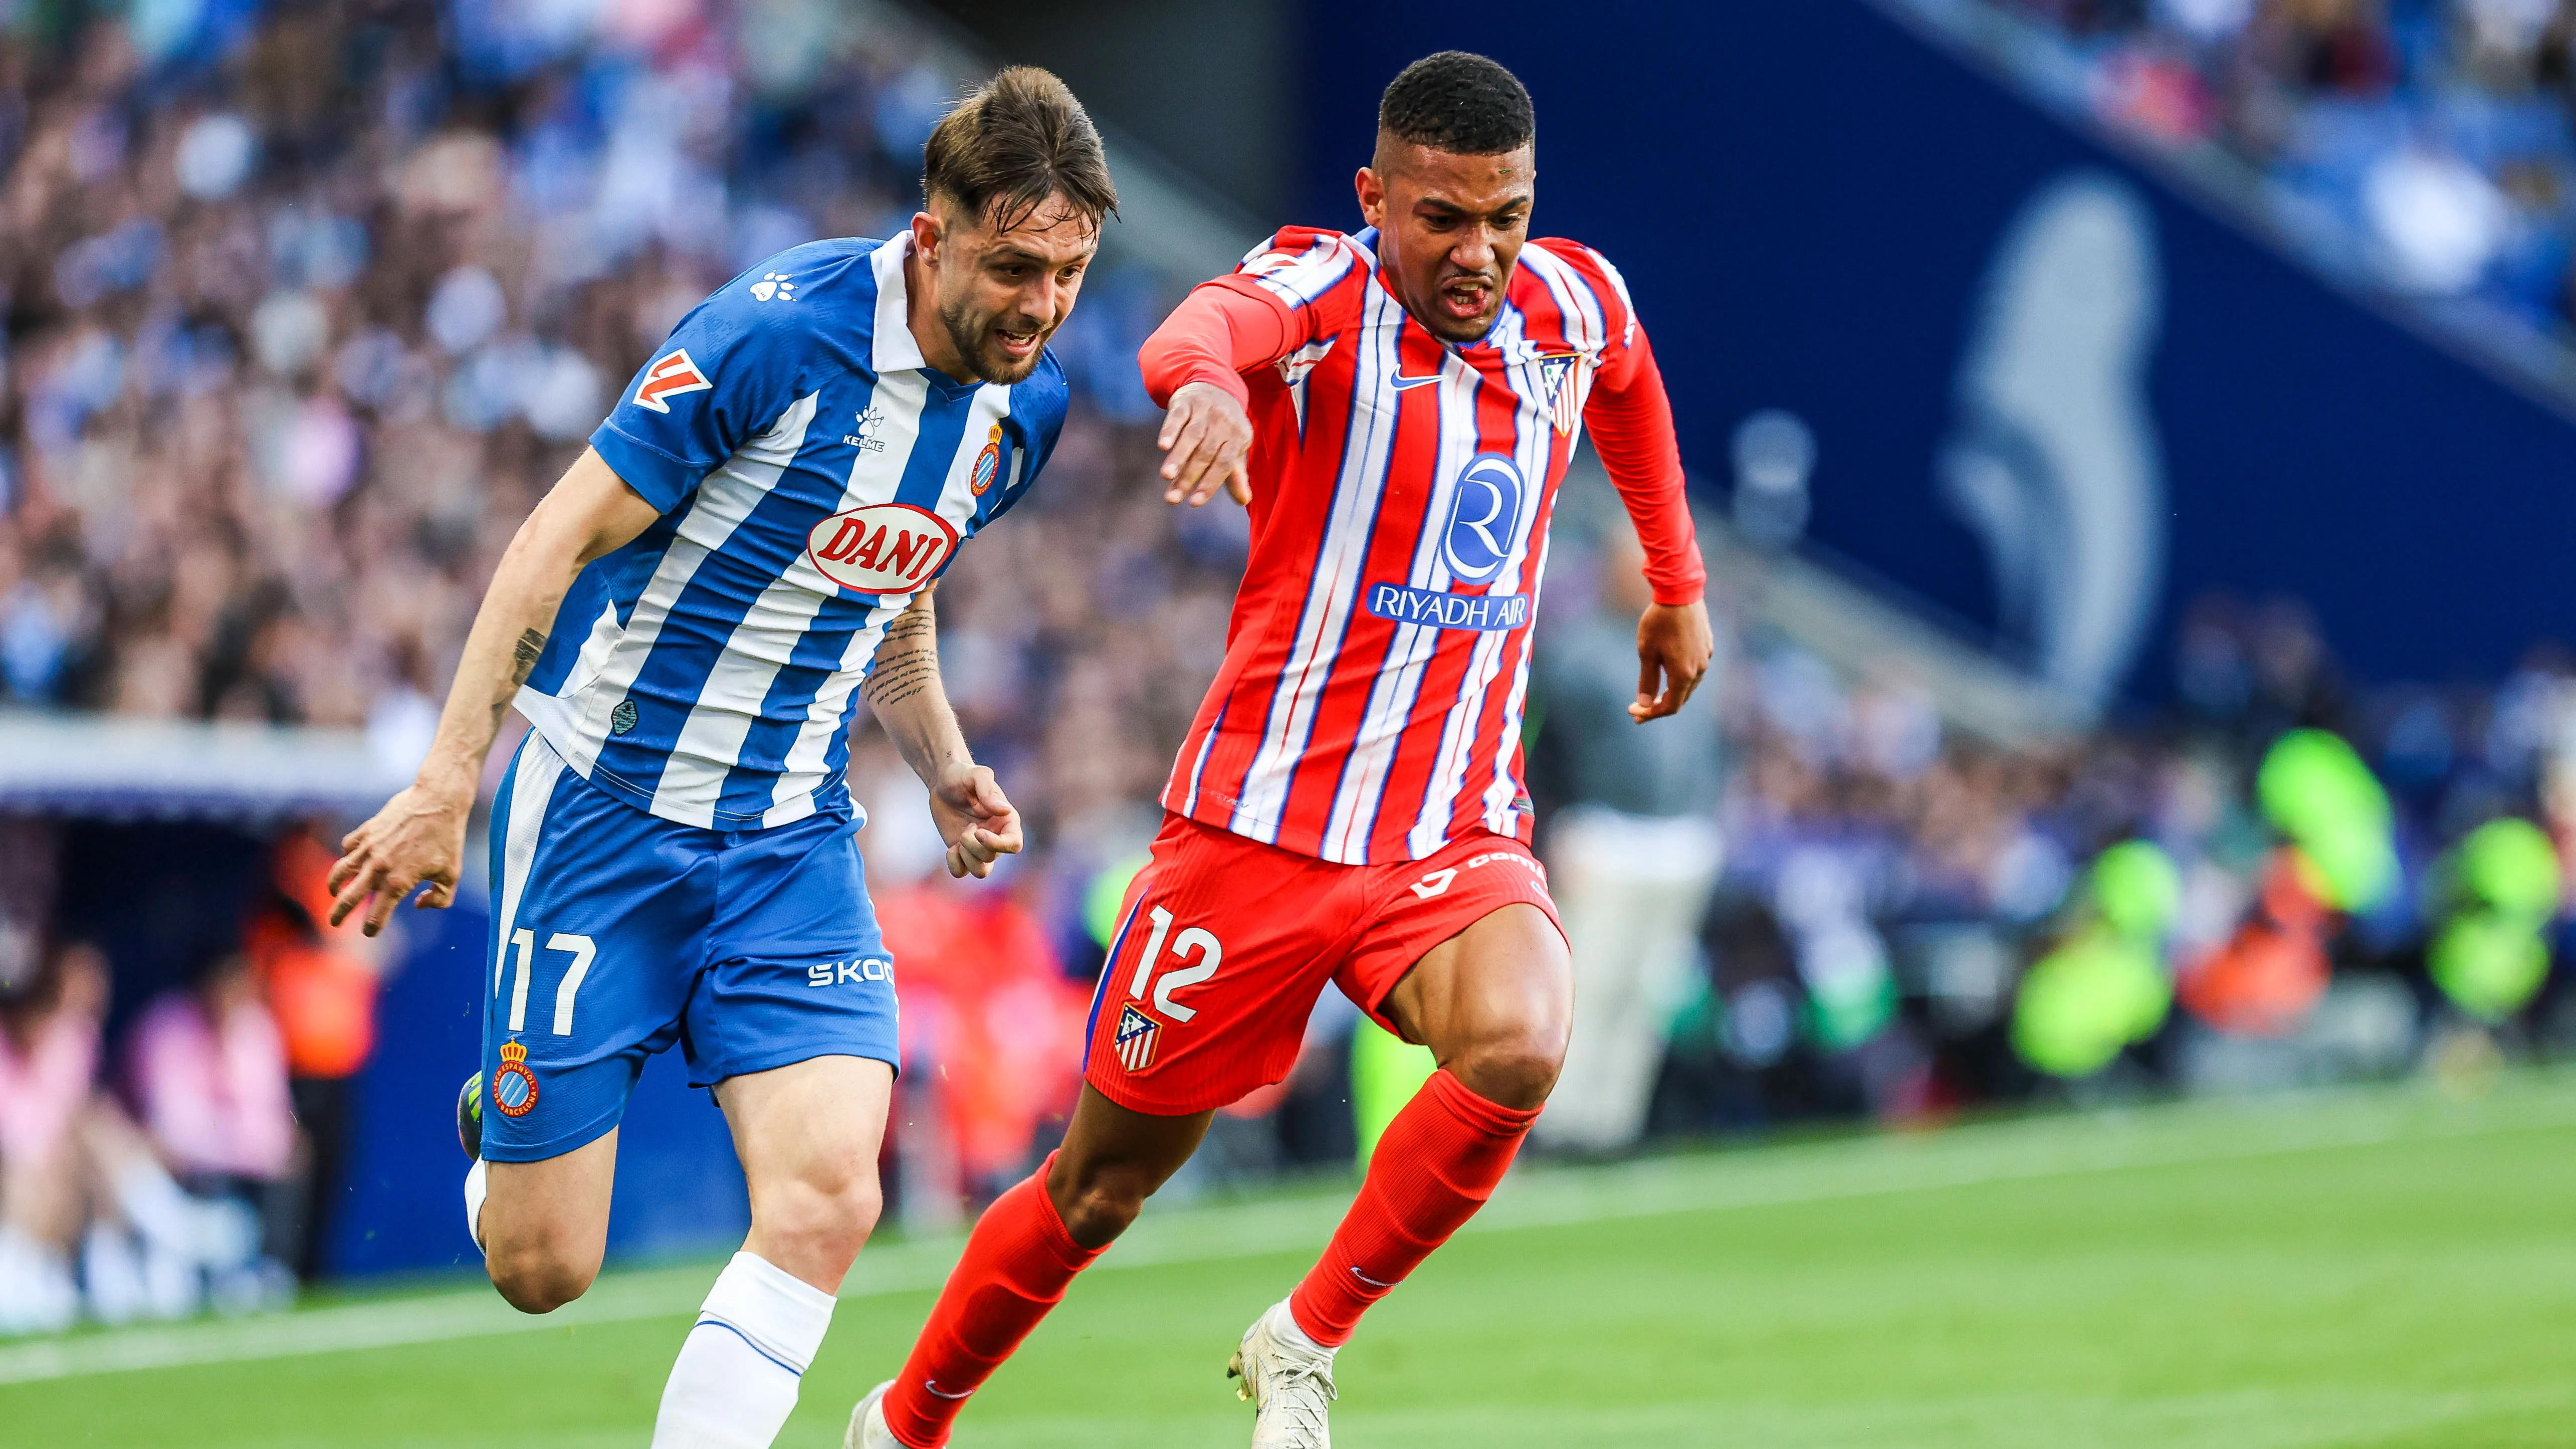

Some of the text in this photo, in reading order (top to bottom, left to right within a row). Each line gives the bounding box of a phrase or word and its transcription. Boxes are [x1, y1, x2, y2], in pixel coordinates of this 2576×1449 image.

[842, 434, 885, 453] KELME
[816, 517, 943, 580] DANI
[1374, 585, 1526, 627] RIYADH AIR
[507, 927, 597, 1037] 17
[1129, 904, 1223, 1023] 12
[501, 1063, 535, 1086] ESPANYOL
[500, 1091, 537, 1116] BARCELONA
